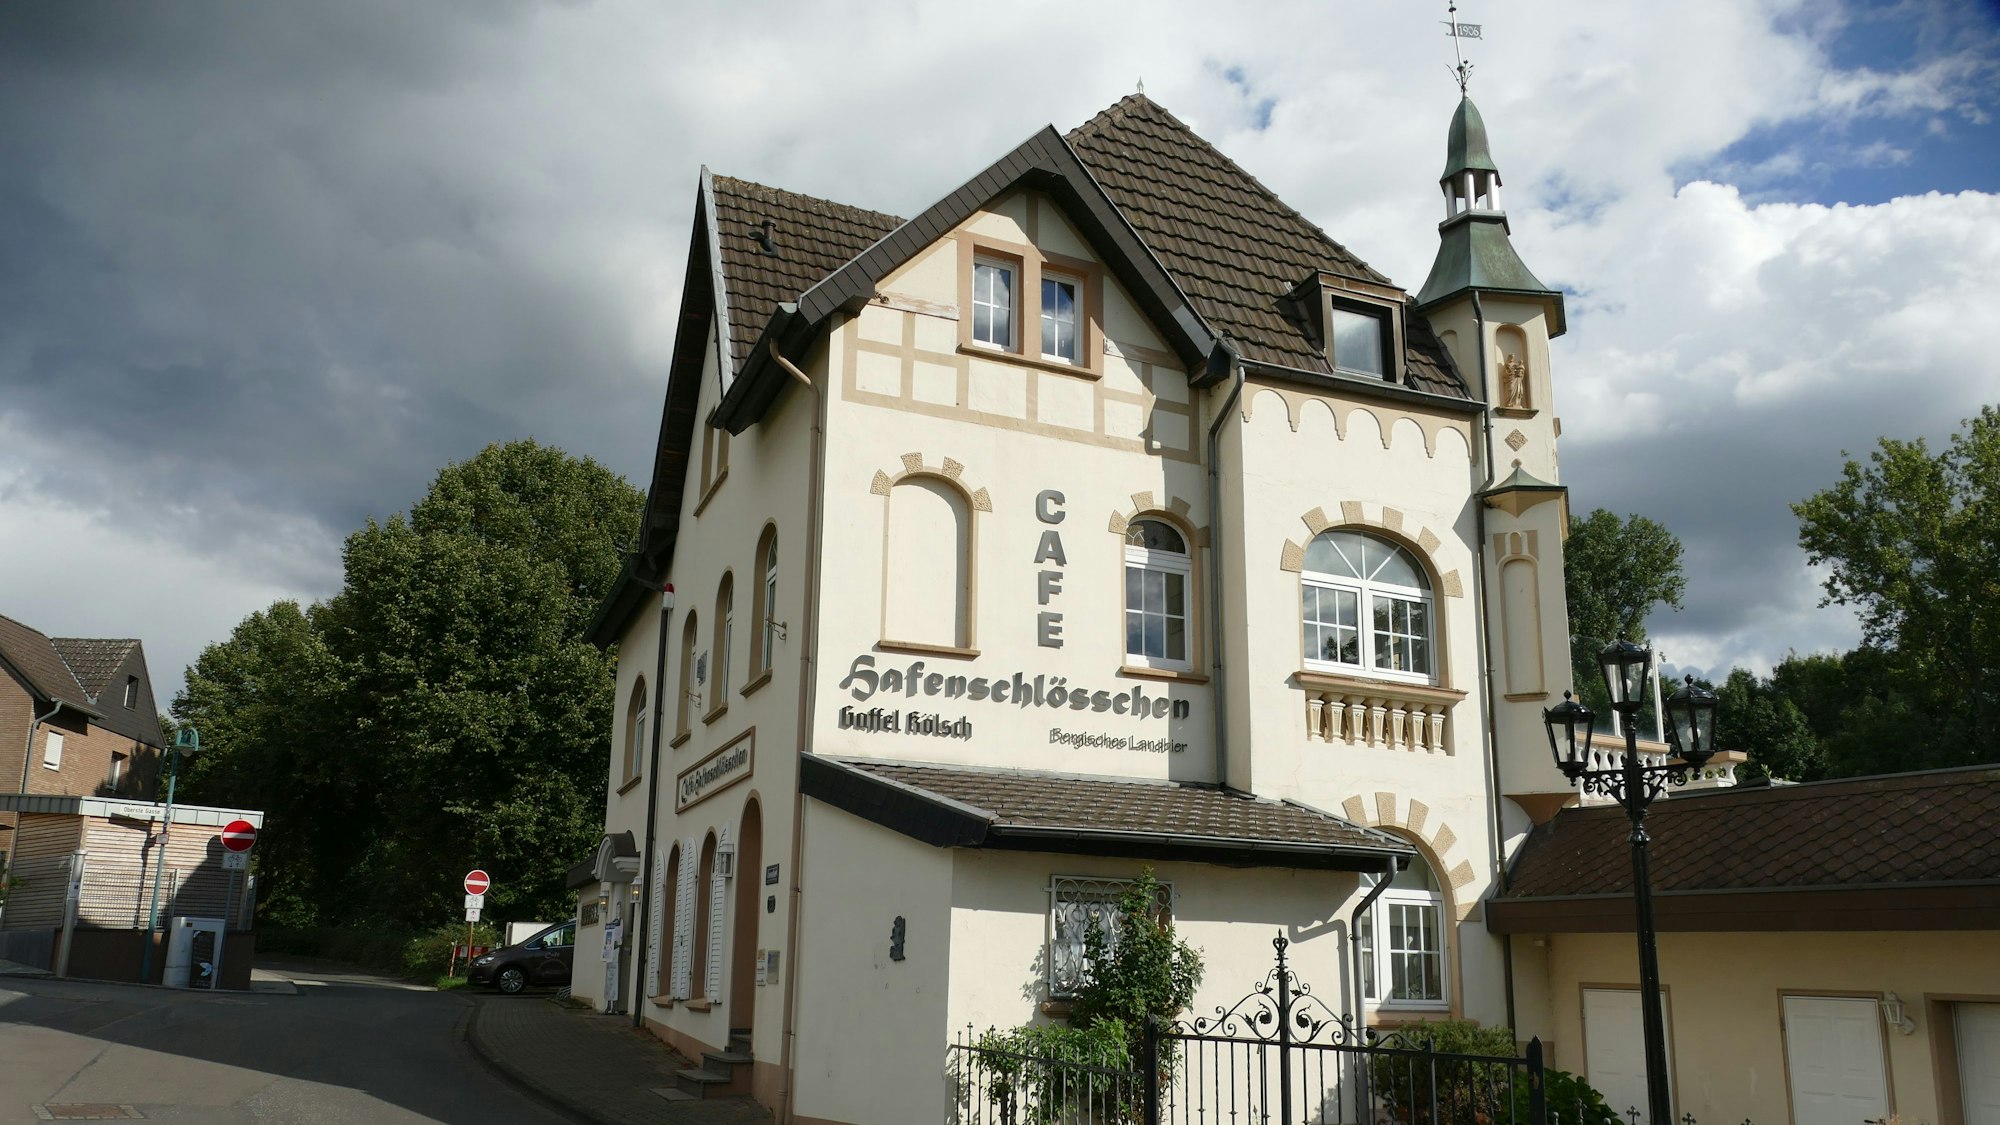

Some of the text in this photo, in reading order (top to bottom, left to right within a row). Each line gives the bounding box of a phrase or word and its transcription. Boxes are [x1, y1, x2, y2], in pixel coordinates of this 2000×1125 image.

[1457, 26, 1480, 36] 1906
[1034, 489, 1067, 649] CAFE
[839, 654, 1190, 721] Hafenschlösschen
[838, 705, 973, 742] Gaffel Kölsch
[1050, 727, 1188, 753] Bergisches Landbier
[123, 806, 144, 814] Oberste
